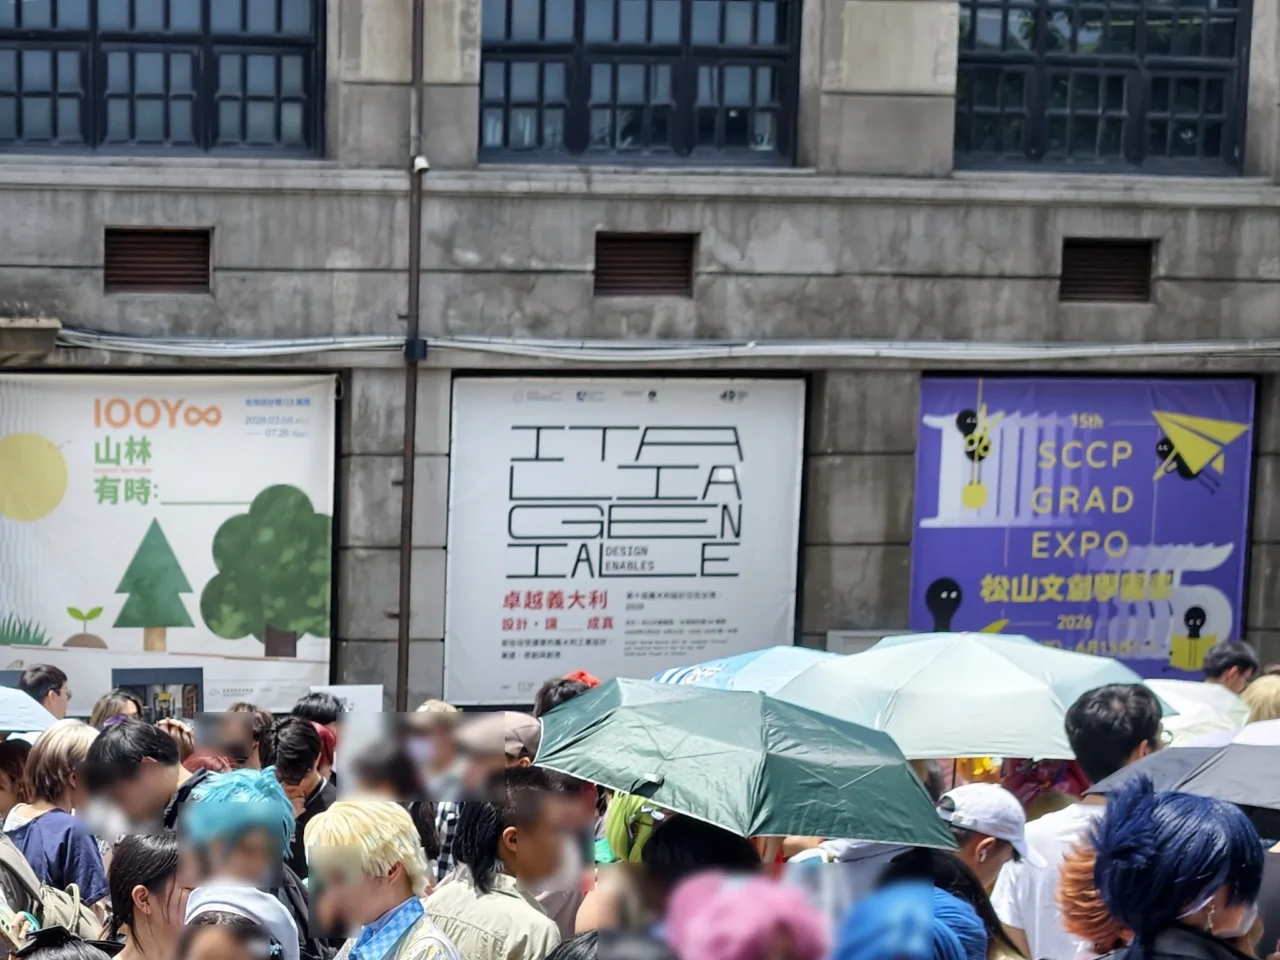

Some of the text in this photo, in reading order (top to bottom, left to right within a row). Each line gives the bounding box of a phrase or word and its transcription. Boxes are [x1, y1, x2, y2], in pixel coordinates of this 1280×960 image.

[1072, 414, 1104, 429] 15th
[94, 435, 152, 465] 山林
[511, 426, 743, 462] ITA
[1038, 442, 1133, 469] SCCP
[508, 465, 742, 501] LIA
[1031, 486, 1134, 513] GRAD
[507, 503, 742, 540] GEN
[605, 546, 648, 557] DESIGN
[1032, 532, 1129, 558] EXPO
[605, 561, 655, 571] ENABLES
[503, 589, 608, 610] 卓越義大利
[1056, 614, 1093, 630] 2026
